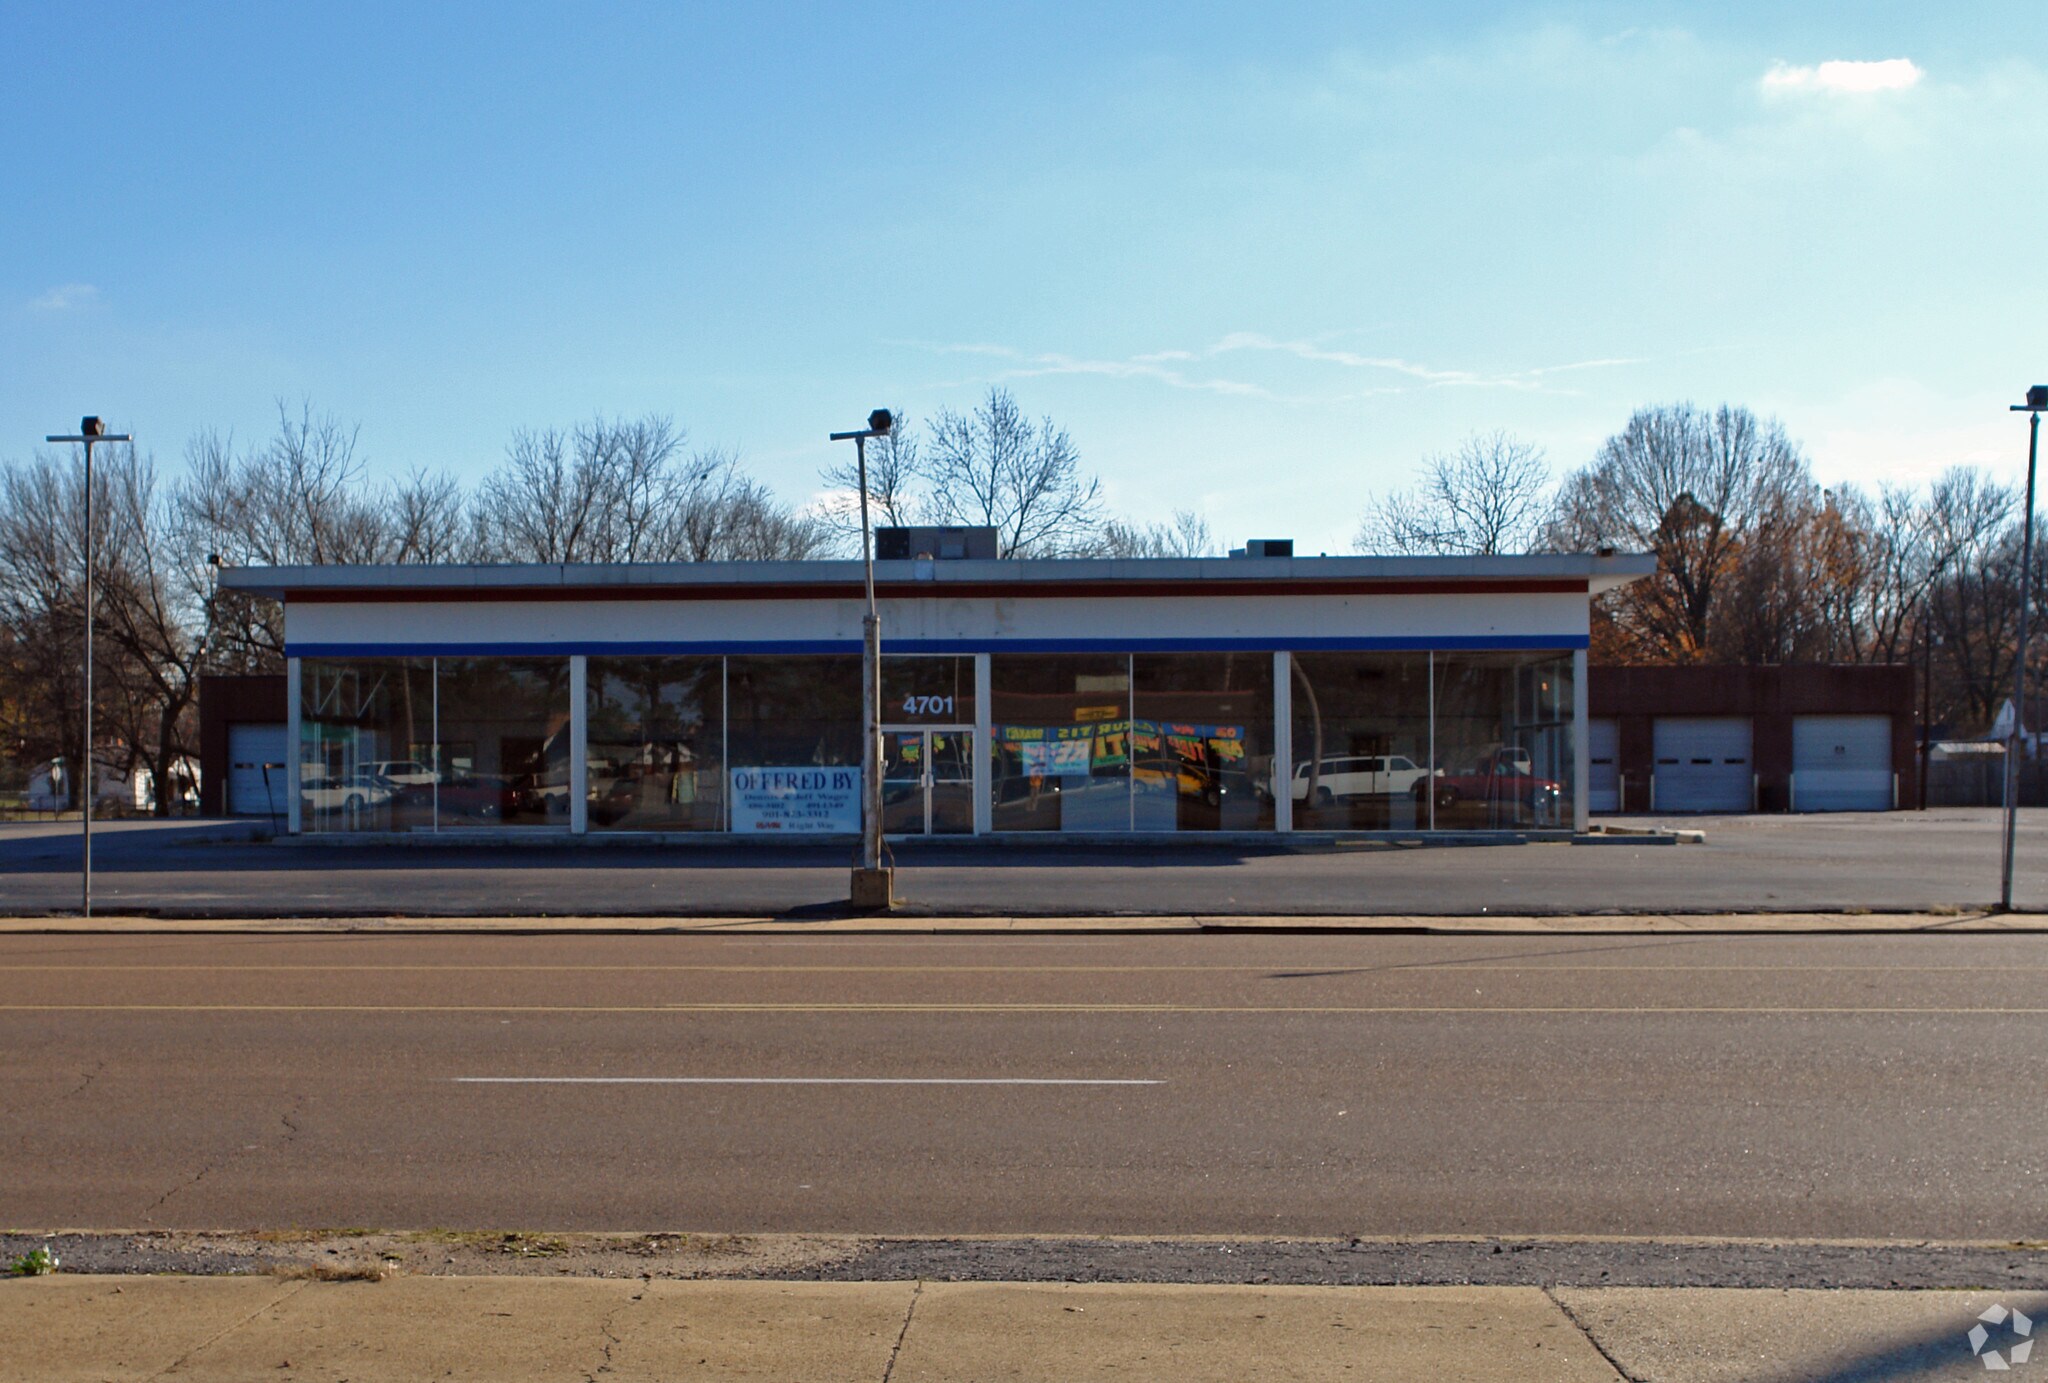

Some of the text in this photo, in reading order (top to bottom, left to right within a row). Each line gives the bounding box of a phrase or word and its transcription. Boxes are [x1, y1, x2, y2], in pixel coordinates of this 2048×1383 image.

[902, 695, 953, 714] 4701
[735, 772, 854, 790] OFFERED BY
